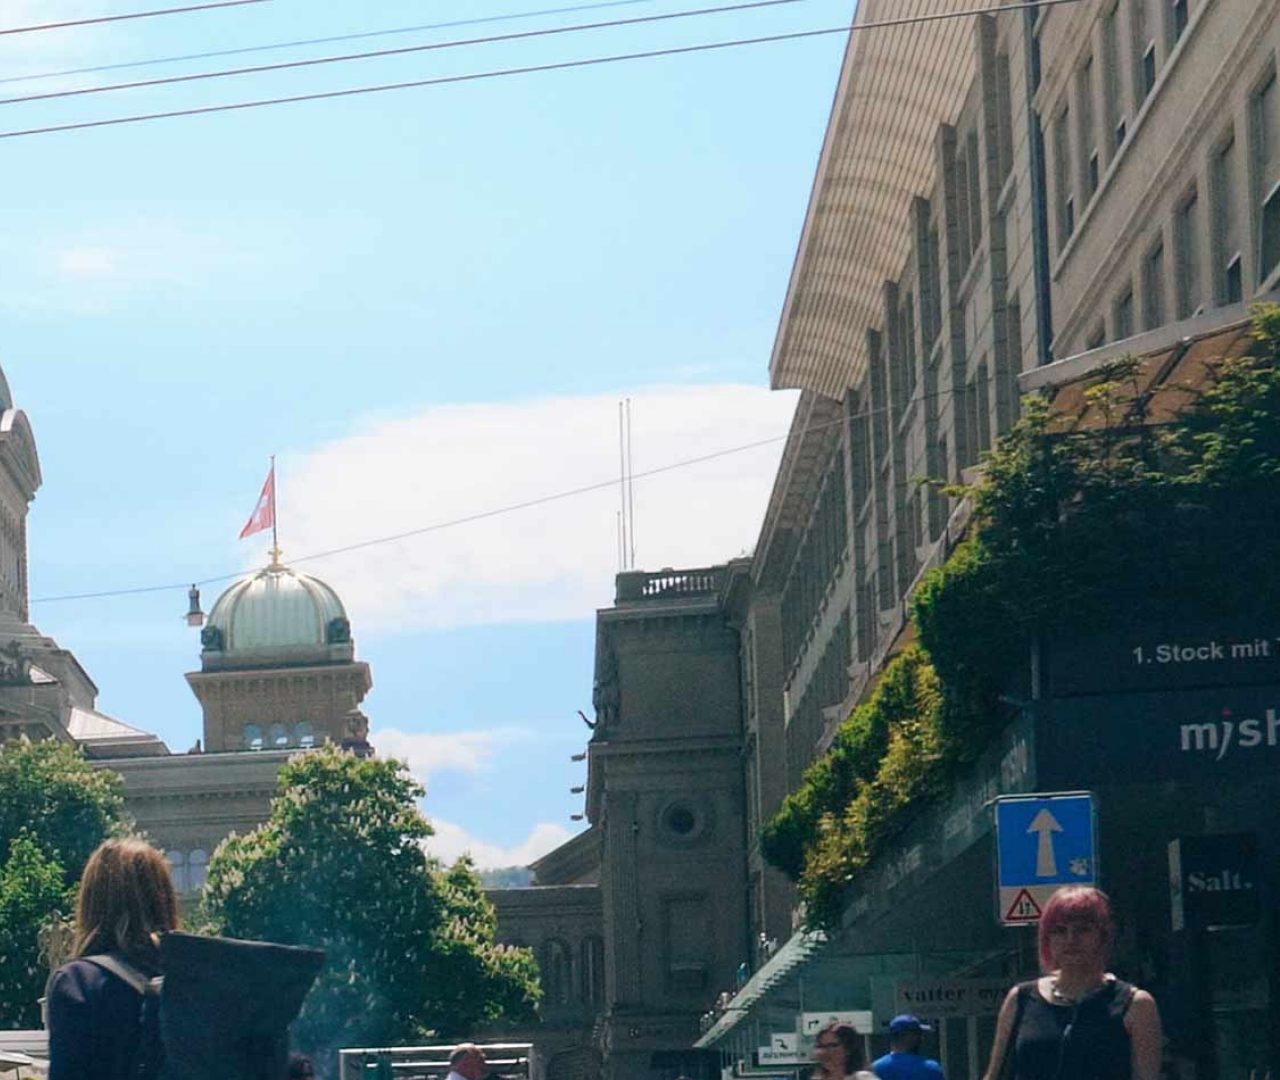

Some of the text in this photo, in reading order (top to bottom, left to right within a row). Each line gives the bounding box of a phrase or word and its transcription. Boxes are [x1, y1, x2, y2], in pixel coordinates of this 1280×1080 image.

[1155, 640, 1224, 663] Stock
[1230, 638, 1271, 659] mit
[1188, 868, 1254, 893] Salt.
